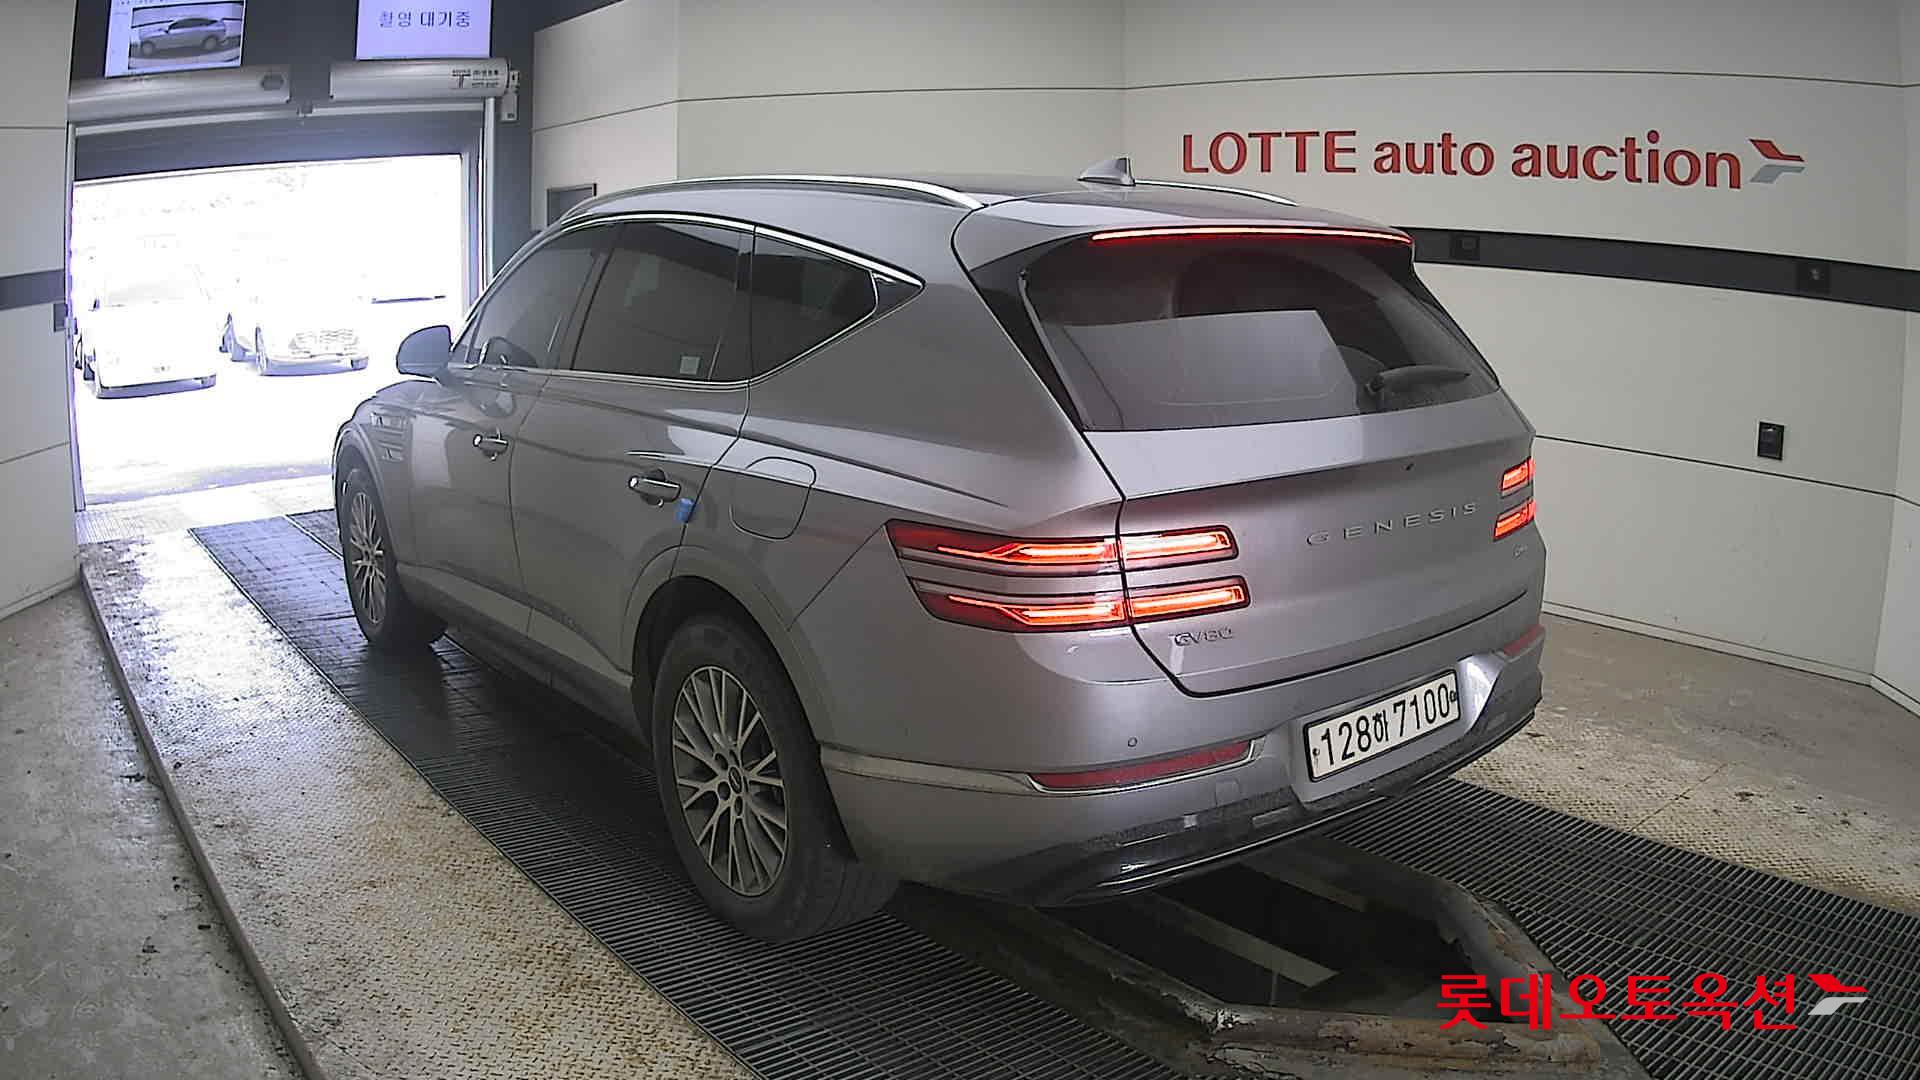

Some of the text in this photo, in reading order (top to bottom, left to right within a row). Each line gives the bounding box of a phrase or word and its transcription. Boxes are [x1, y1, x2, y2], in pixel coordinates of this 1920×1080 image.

[420, 10, 470, 28] 대기중
[1182, 130, 1742, 189] LOTTE auto auction
[1306, 502, 1477, 546] GENESIS
[1320, 683, 1451, 766] 128하 7100
